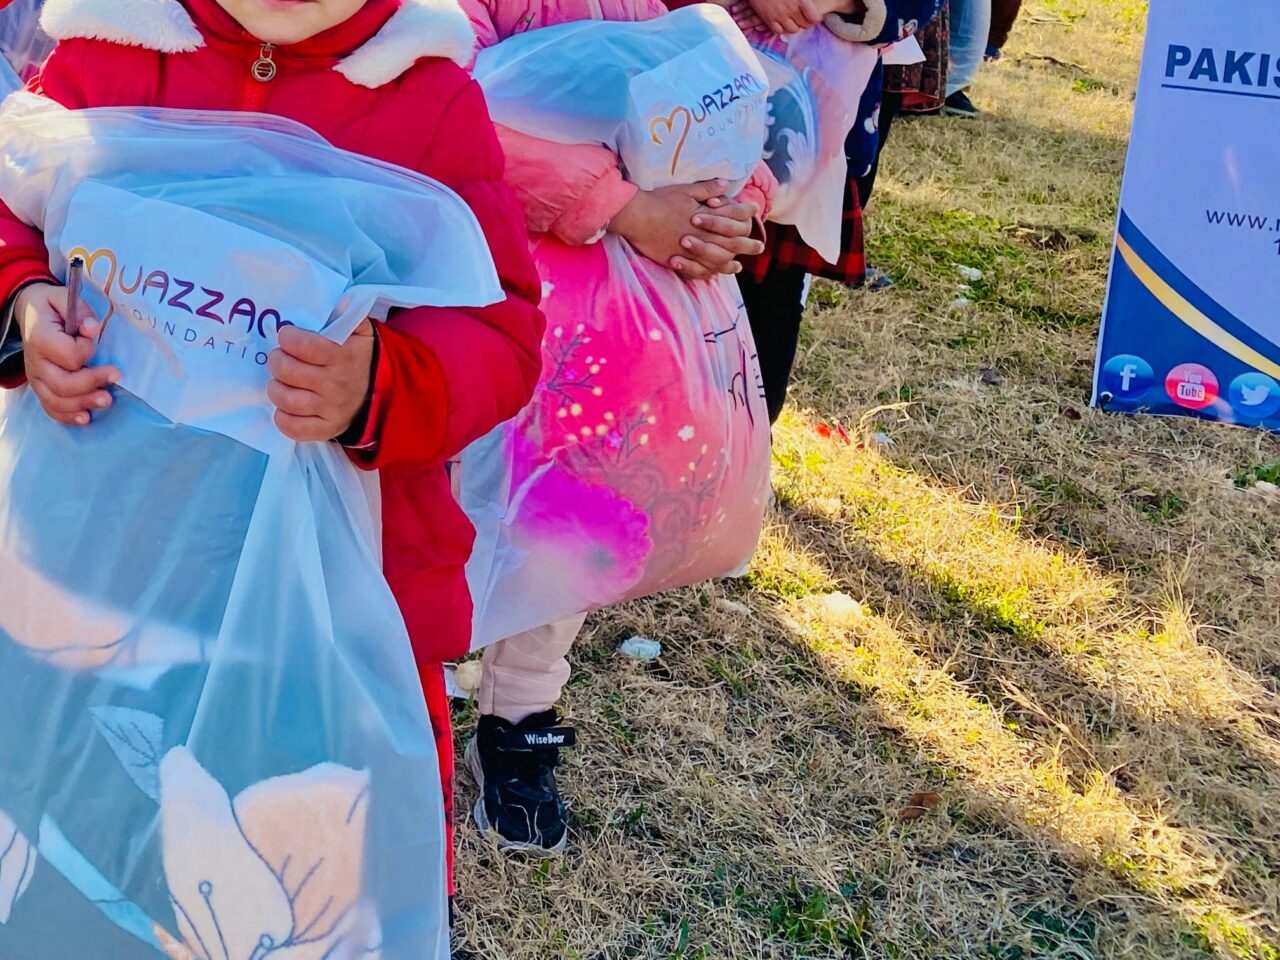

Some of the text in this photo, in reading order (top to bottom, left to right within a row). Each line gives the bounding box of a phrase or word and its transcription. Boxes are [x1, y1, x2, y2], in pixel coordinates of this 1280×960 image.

[1165, 44, 1280, 88] PAKI
[649, 72, 762, 176] MUAZZAM
[1205, 209, 1280, 232] www.
[122, 302, 268, 365] OUNDATIO
[1180, 384, 1203, 399] Tube
[1183, 369, 1202, 384] You
